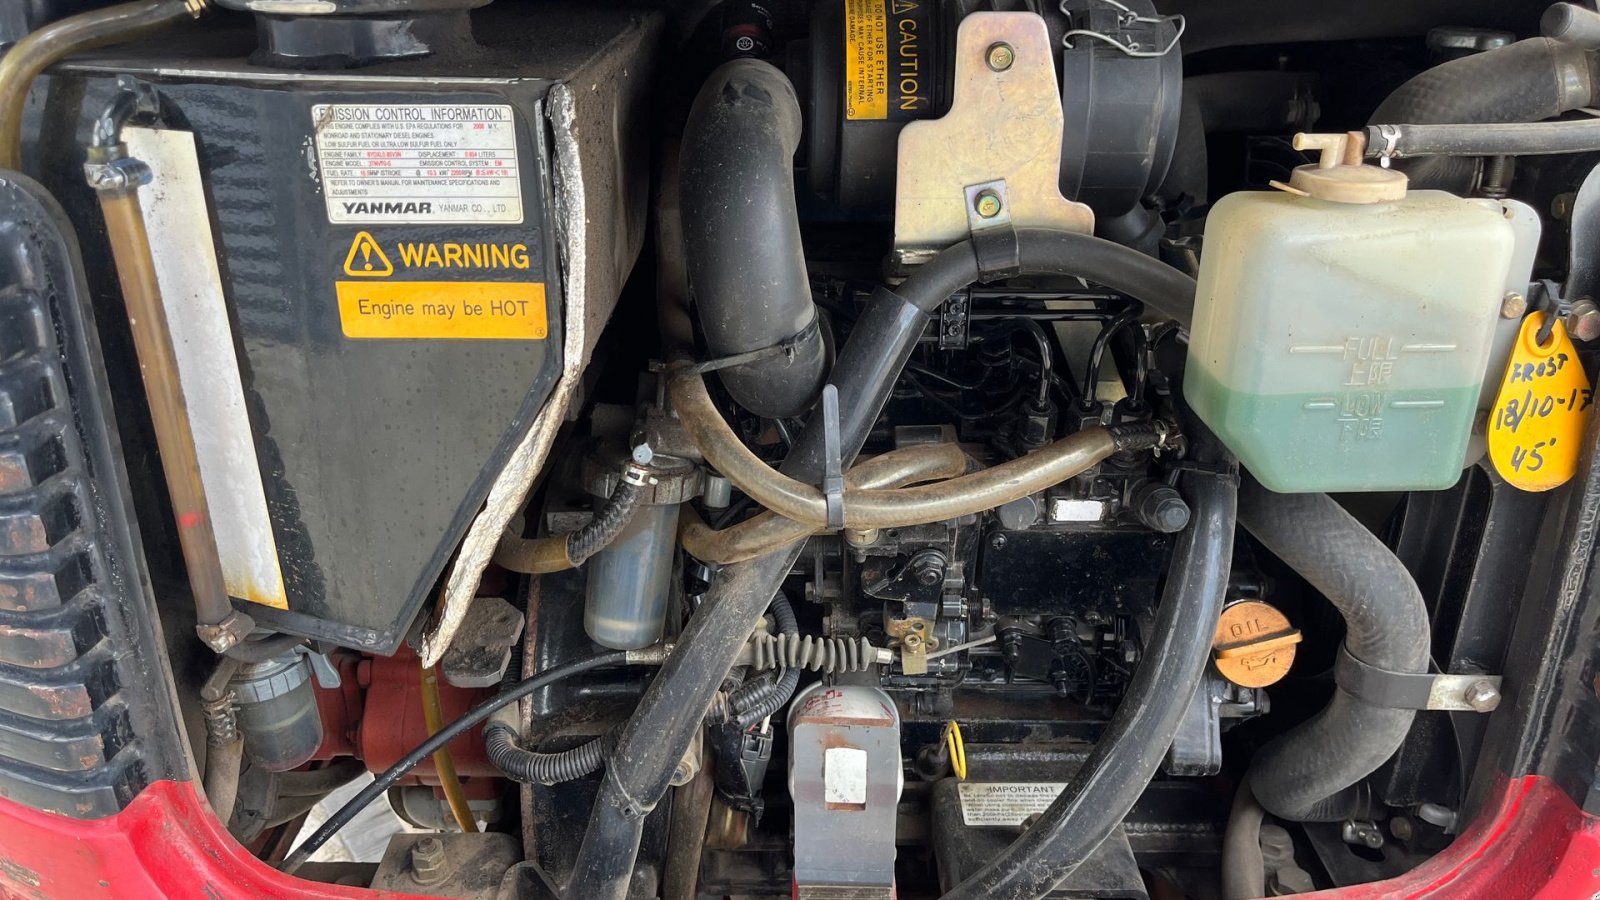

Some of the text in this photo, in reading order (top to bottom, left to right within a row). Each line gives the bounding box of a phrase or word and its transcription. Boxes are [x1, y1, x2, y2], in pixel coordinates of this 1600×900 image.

[874, 4, 882, 13] DO
[876, 16, 884, 32] NOT
[899, 19, 918, 110] CAUTION
[376, 108, 425, 120] CONTROL
[431, 108, 502, 120] INFORMATION
[343, 202, 432, 214] YANMAR
[439, 204, 468, 213] YANMAR
[398, 243, 530, 269] WARNING
[358, 299, 529, 320] Engine may be HOT
[1343, 336, 1398, 360] FULL
[1510, 353, 1569, 383] FROST
[1340, 392, 1388, 417] LOW
[1230, 618, 1269, 638] OIL
